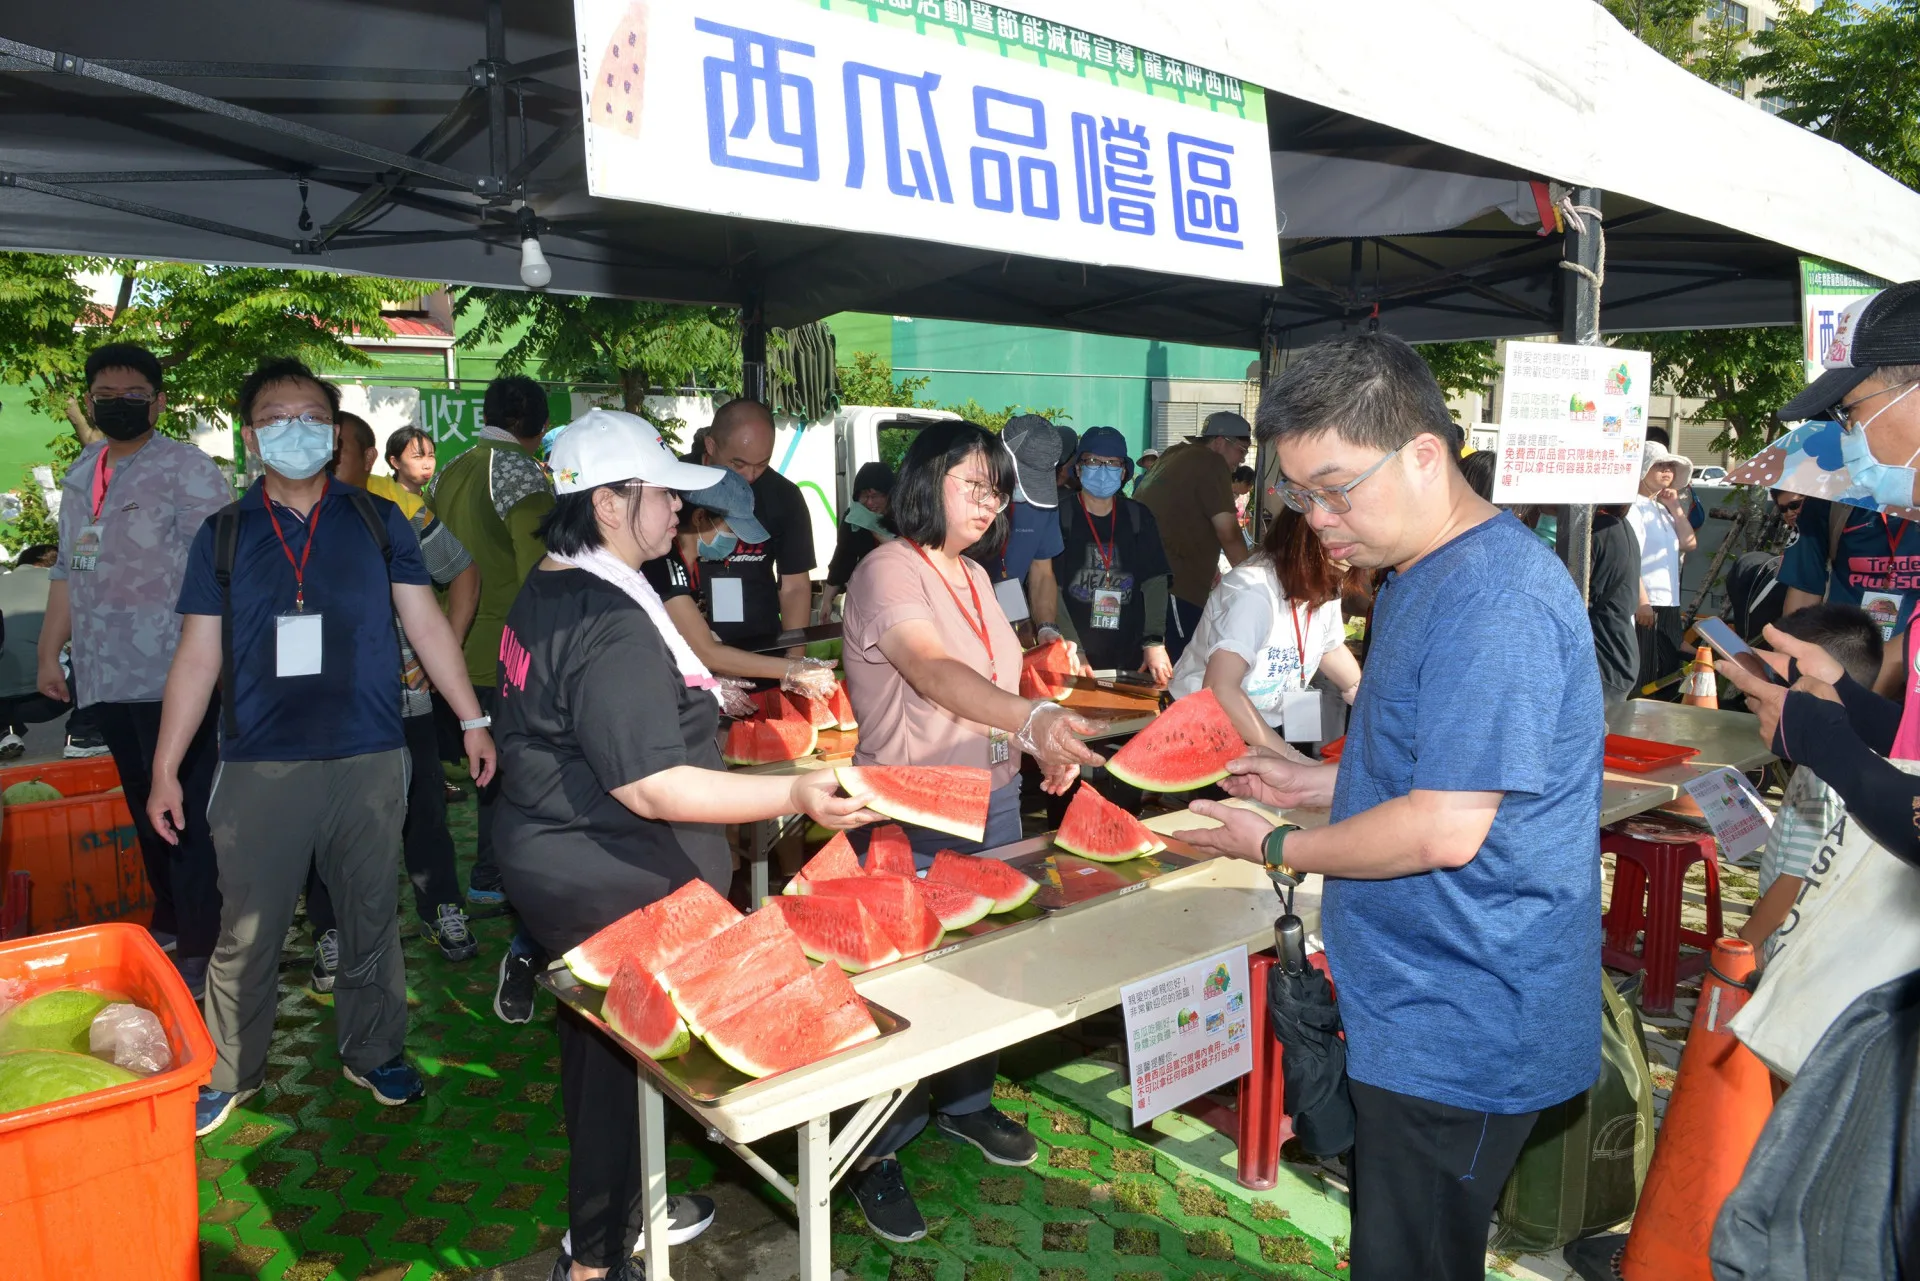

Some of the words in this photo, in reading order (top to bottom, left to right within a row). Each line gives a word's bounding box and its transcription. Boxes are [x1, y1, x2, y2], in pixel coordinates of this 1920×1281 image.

[694, 17, 1243, 250] 西瓜品嚐區
